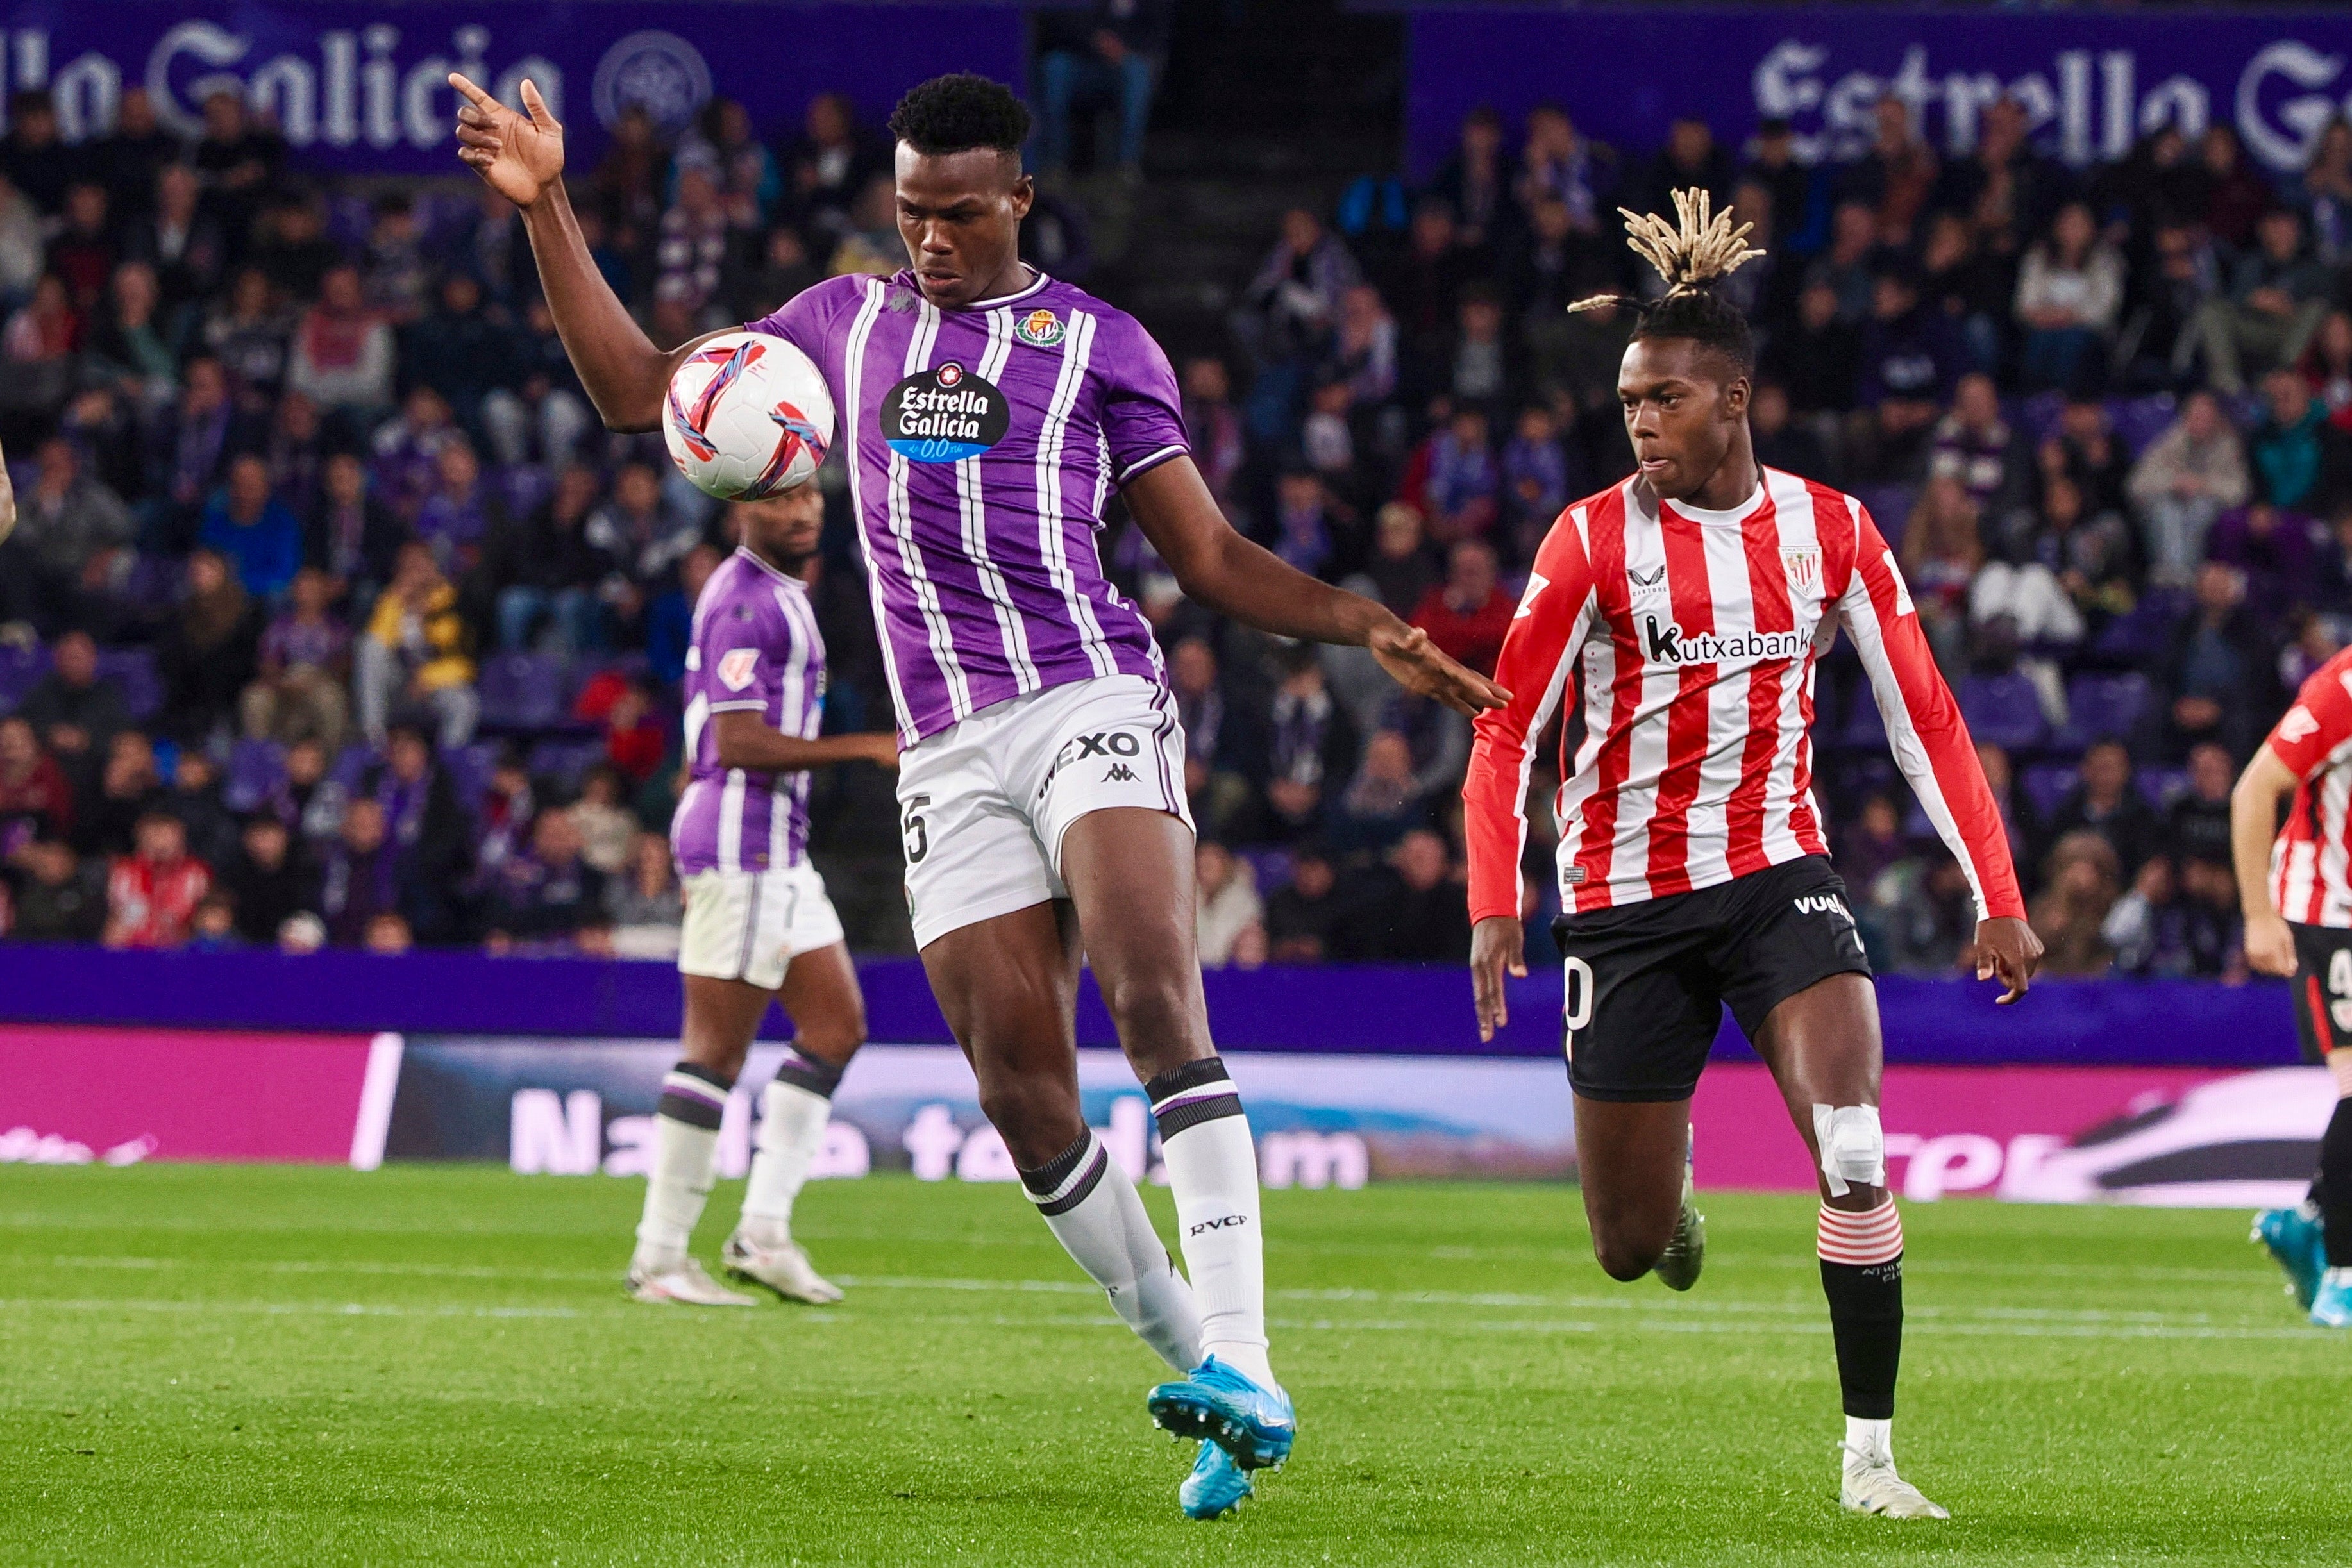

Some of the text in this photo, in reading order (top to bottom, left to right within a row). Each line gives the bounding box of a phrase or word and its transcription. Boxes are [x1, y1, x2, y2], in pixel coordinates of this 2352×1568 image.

[0, 27, 122, 146] la
[2234, 40, 2352, 172] G
[899, 386, 989, 415] Estrella
[899, 410, 979, 438] Galicia
[920, 438, 950, 458] 0,0
[1039, 732, 1140, 800] EXO
[904, 796, 930, 863] 5
